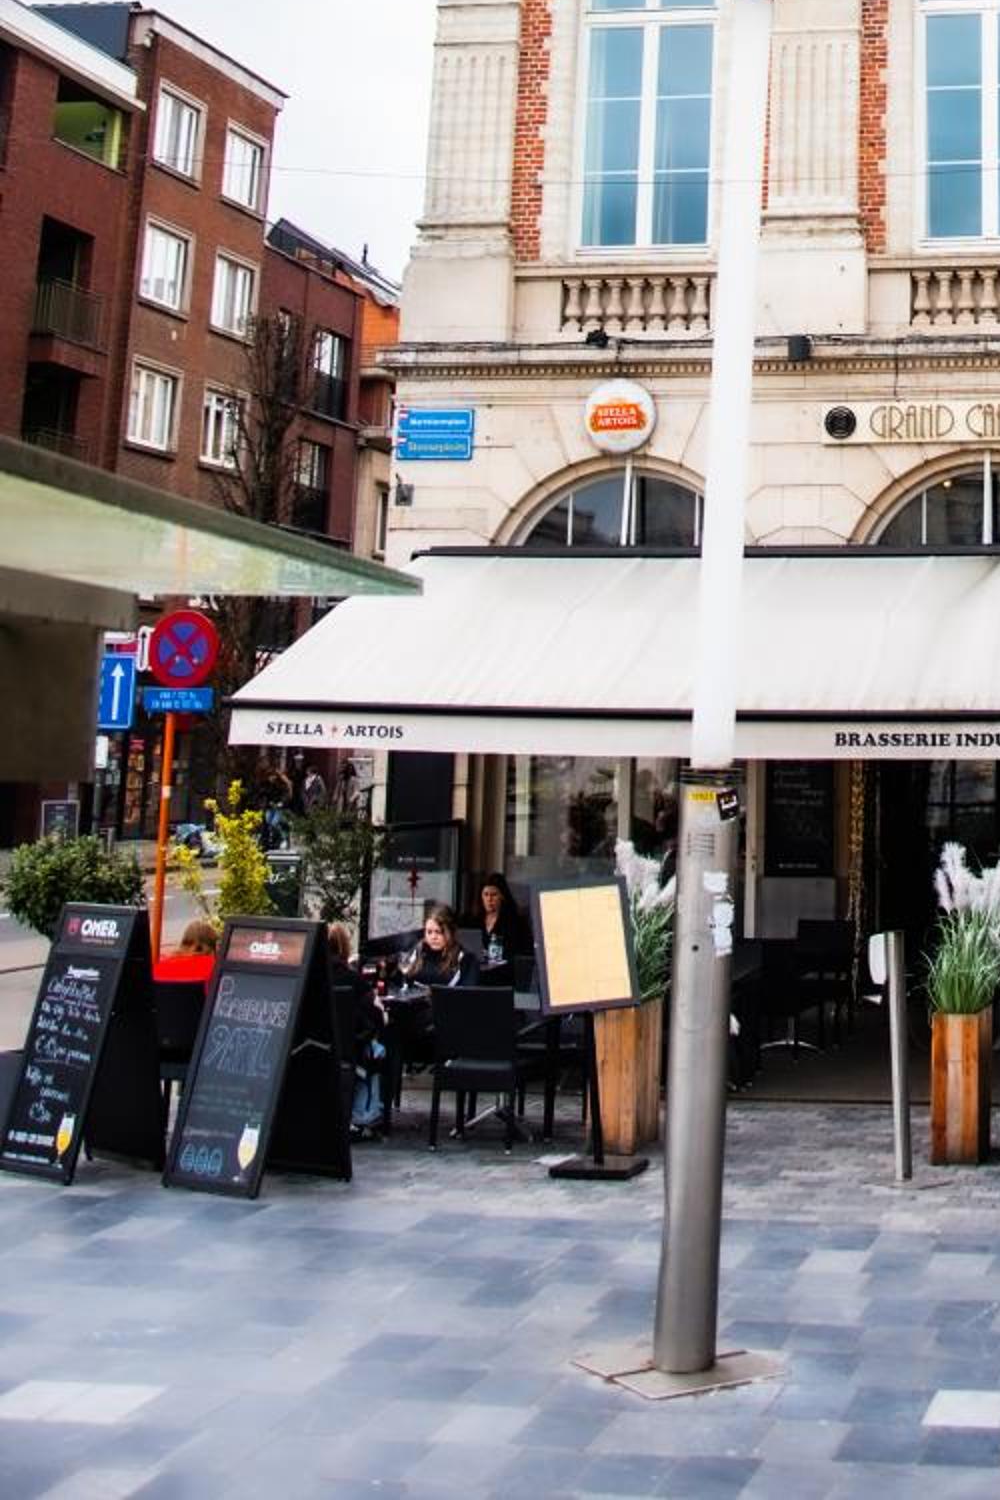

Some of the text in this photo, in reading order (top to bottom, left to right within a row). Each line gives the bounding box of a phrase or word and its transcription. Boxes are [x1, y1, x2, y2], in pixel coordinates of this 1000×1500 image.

[868, 404, 955, 439] GRAND
[266, 721, 404, 739] STELLA ARTOIS
[835, 732, 951, 748] BRASSERIE
